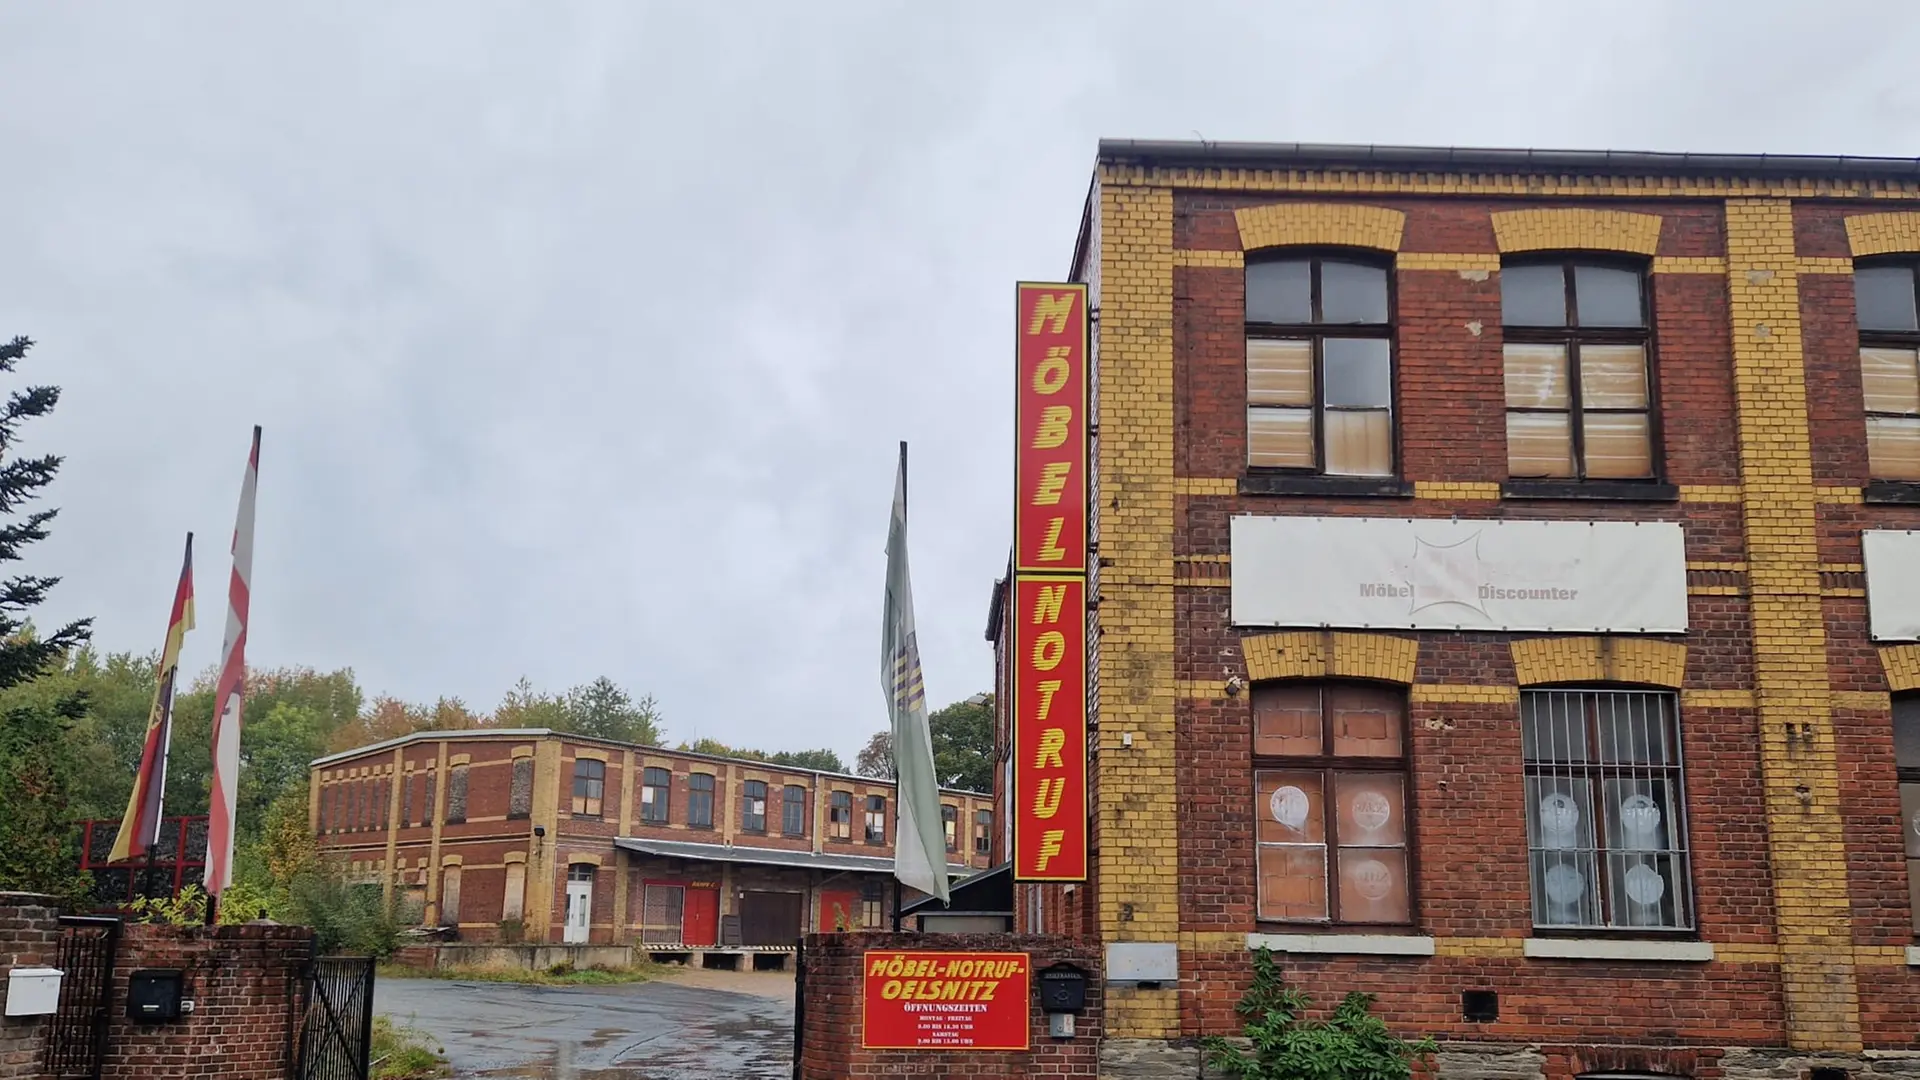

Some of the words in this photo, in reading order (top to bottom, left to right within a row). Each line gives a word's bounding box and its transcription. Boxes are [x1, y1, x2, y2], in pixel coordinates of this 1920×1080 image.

[1026, 292, 1076, 562] MÖBEL
[1359, 582, 1415, 598] Möbel
[1477, 585, 1578, 600] Discounter
[1031, 584, 1067, 872] NOTRUF
[869, 955, 1024, 979] MÖBEL-NOTRUF-
[881, 980, 1000, 1001] OELSNITZ
[904, 1002, 988, 1013] ÖFFNUNGSZEITEN
